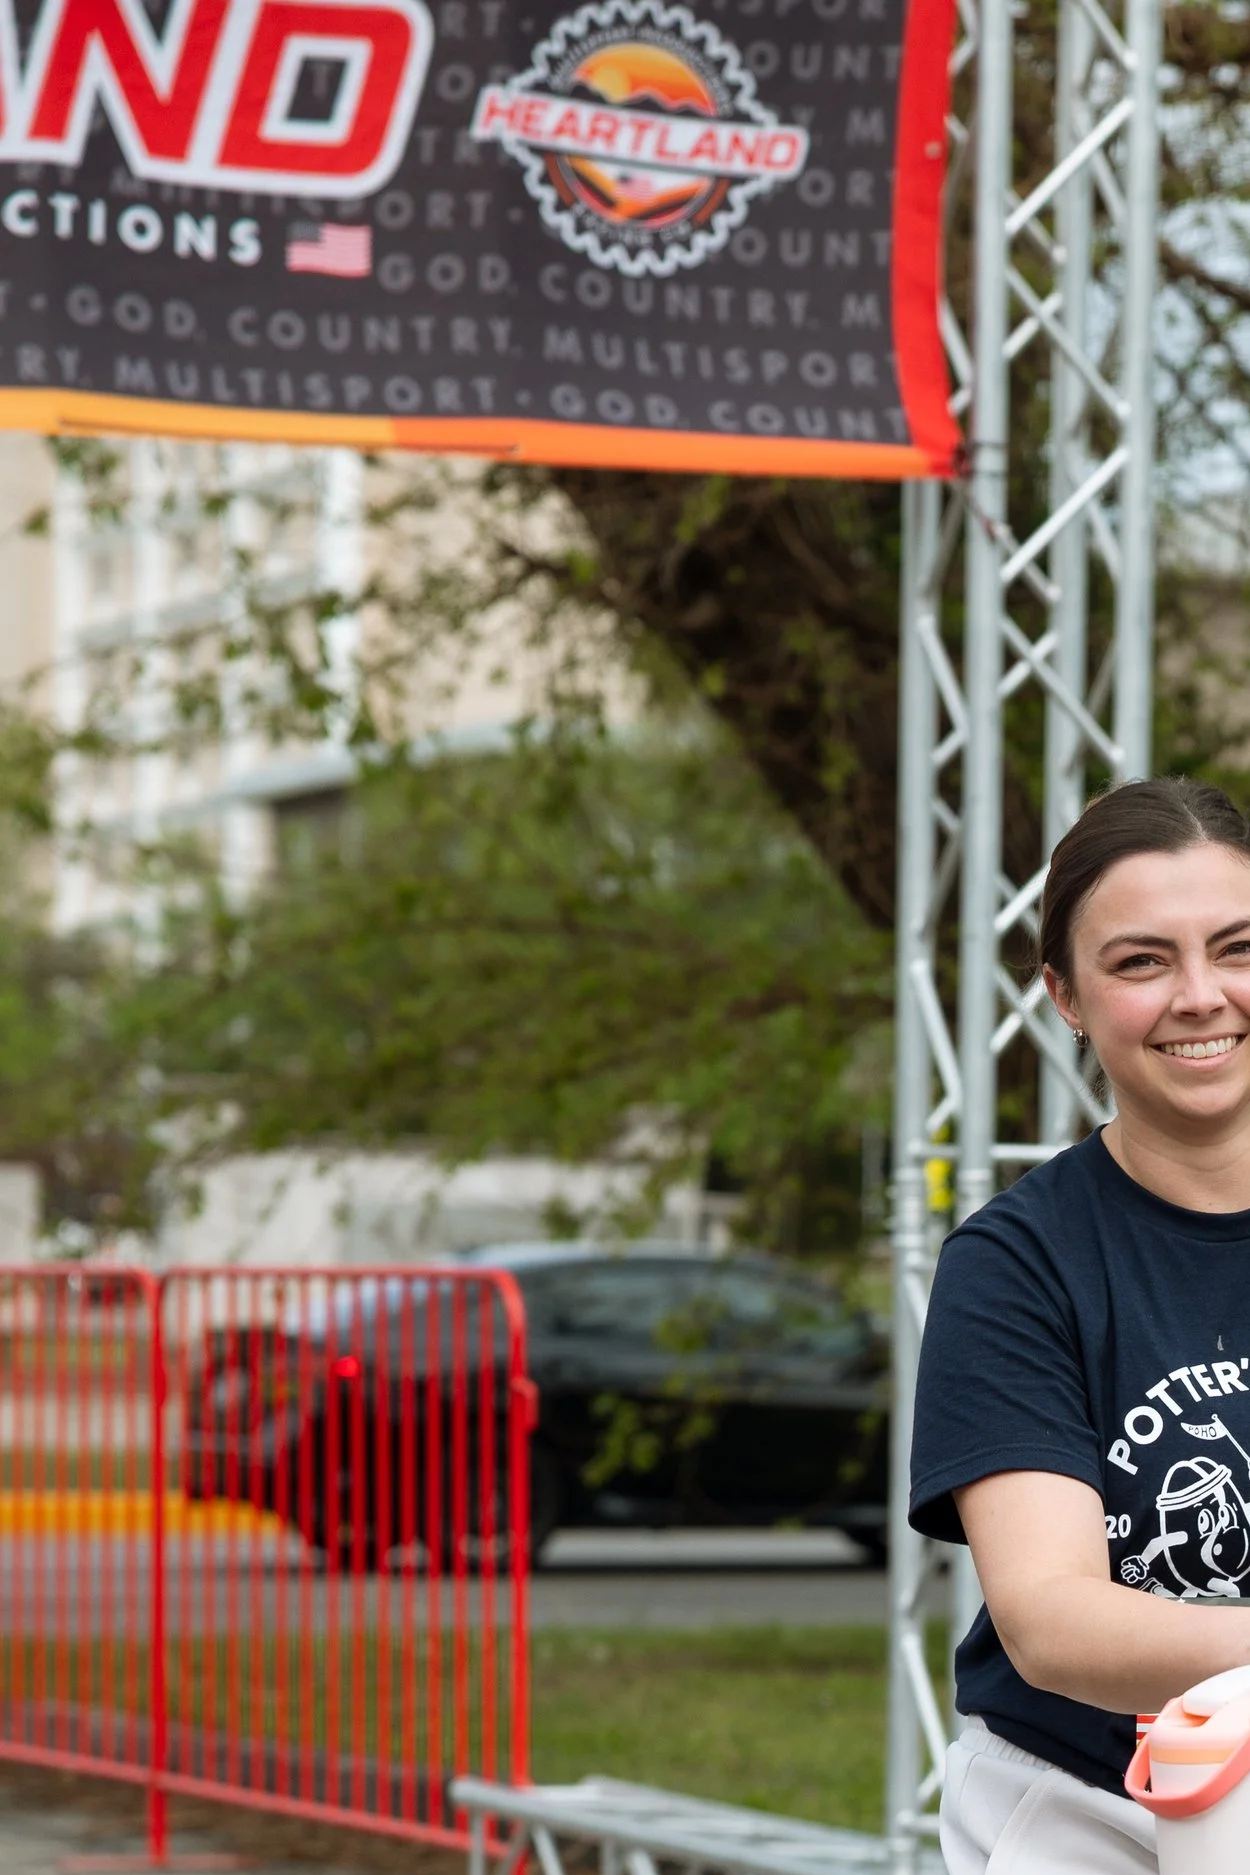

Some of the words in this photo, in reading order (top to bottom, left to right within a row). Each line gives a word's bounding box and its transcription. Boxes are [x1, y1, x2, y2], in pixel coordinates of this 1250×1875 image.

[0, 0, 434, 198] ND
[480, 94, 803, 171] HEARTLAND
[2, 190, 262, 266] CTIONS
[114, 354, 497, 413] MULTISPORT
[543, 324, 902, 390] MULTISPOR
[1188, 1425, 1217, 1438] POHO
[1104, 1513, 1132, 1539] 20
